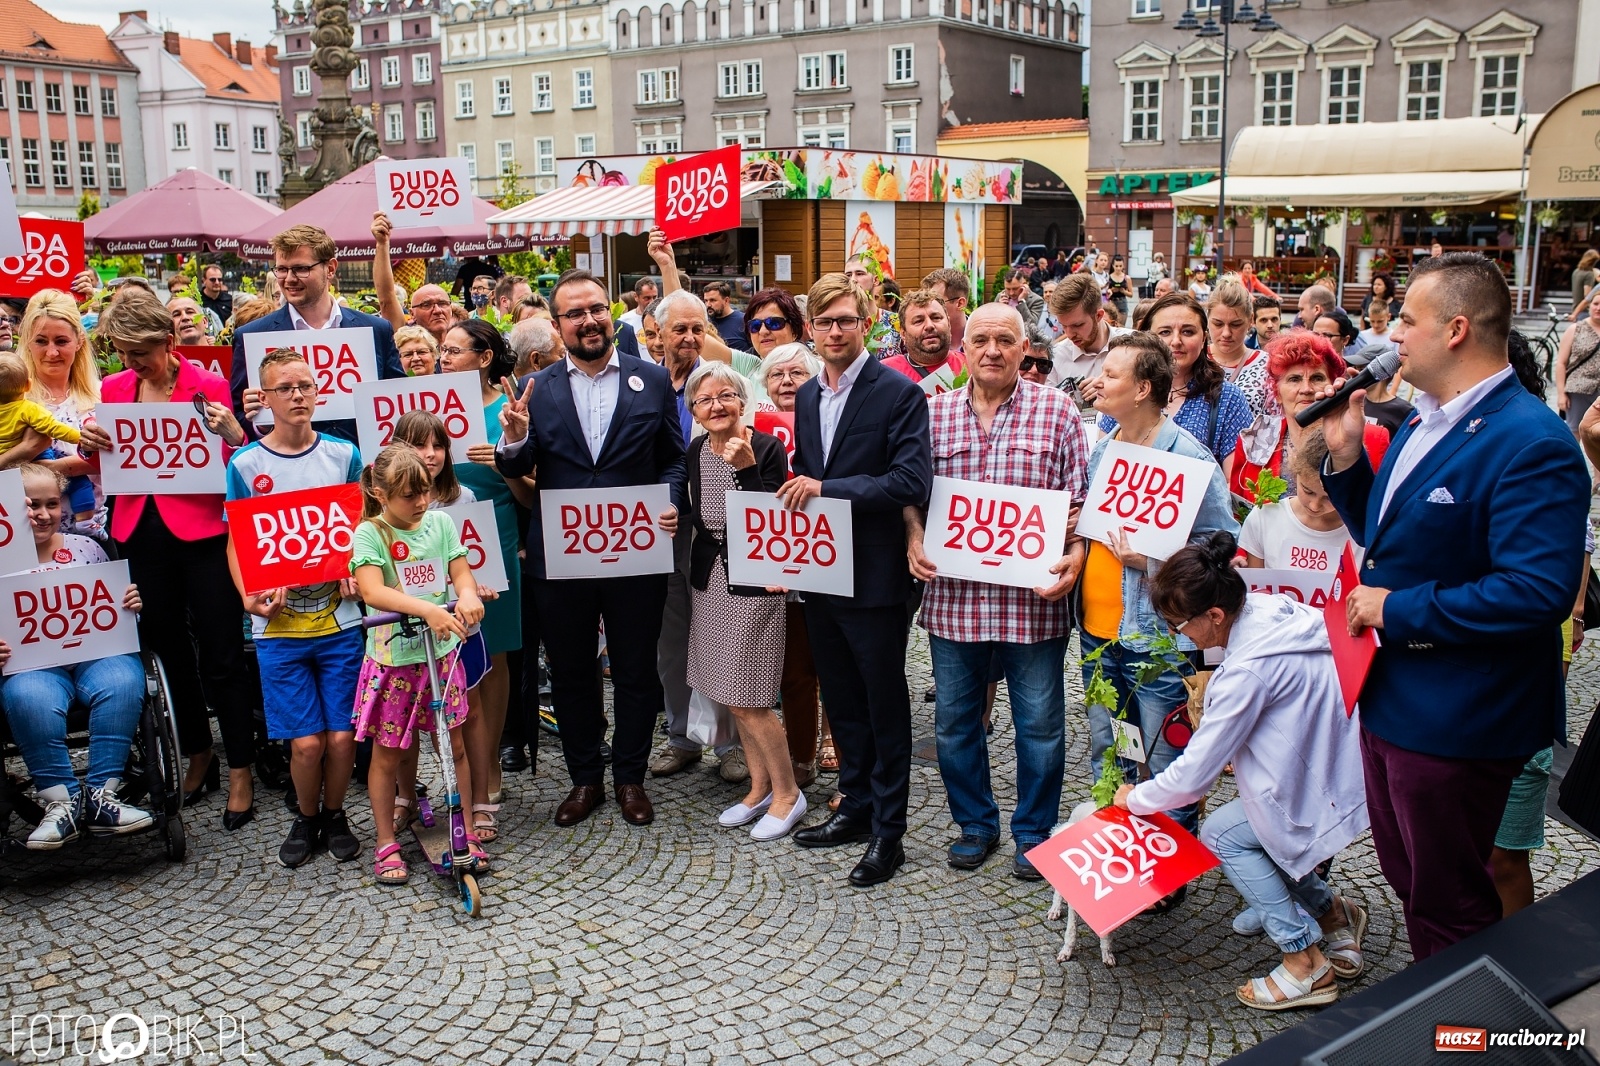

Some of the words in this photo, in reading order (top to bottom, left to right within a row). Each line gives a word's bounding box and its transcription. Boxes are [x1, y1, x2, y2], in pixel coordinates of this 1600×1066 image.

[389, 168, 458, 191] DUDA
[667, 162, 728, 199] DUDA
[1098, 172, 1217, 195] APTEK
[391, 187, 460, 210] 2020
[665, 184, 729, 221] 2020
[25, 231, 69, 257] DA
[106, 240, 147, 254] Gelateria
[148, 238, 169, 249] Ciao
[170, 237, 198, 248] Italia
[214, 238, 240, 250] Gelat
[389, 247, 403, 255] ao
[405, 242, 437, 254] Italia
[453, 241, 485, 255] Gelateria
[486, 239, 502, 250] Ciao
[504, 238, 525, 249] Italia
[0, 253, 70, 278] 020
[265, 343, 359, 369] DA
[316, 368, 362, 395] 20
[373, 388, 466, 422] DUDA
[115, 418, 207, 444] DUDA
[378, 413, 469, 447] 20
[119, 442, 210, 470] 2020
[1107, 458, 1185, 503] DUDA
[252, 501, 351, 541] DUDA
[561, 501, 653, 531] DUDA
[948, 494, 1046, 533] DUDA
[1098, 485, 1179, 530] 2020
[745, 507, 835, 542] DUDA
[256, 525, 355, 566] 2020
[563, 525, 656, 555] 2020
[747, 534, 838, 567] 2020
[943, 522, 1046, 560] 2020
[1291, 546, 1328, 561] DUDA
[403, 564, 435, 577] DUDA
[1289, 556, 1328, 571] 2020
[405, 572, 436, 586] 2020
[14, 579, 115, 619] DUDA
[1250, 584, 1329, 609] DA
[19, 605, 119, 645] 2020
[1059, 815, 1161, 877] DUDA
[1080, 832, 1178, 901] 2020
